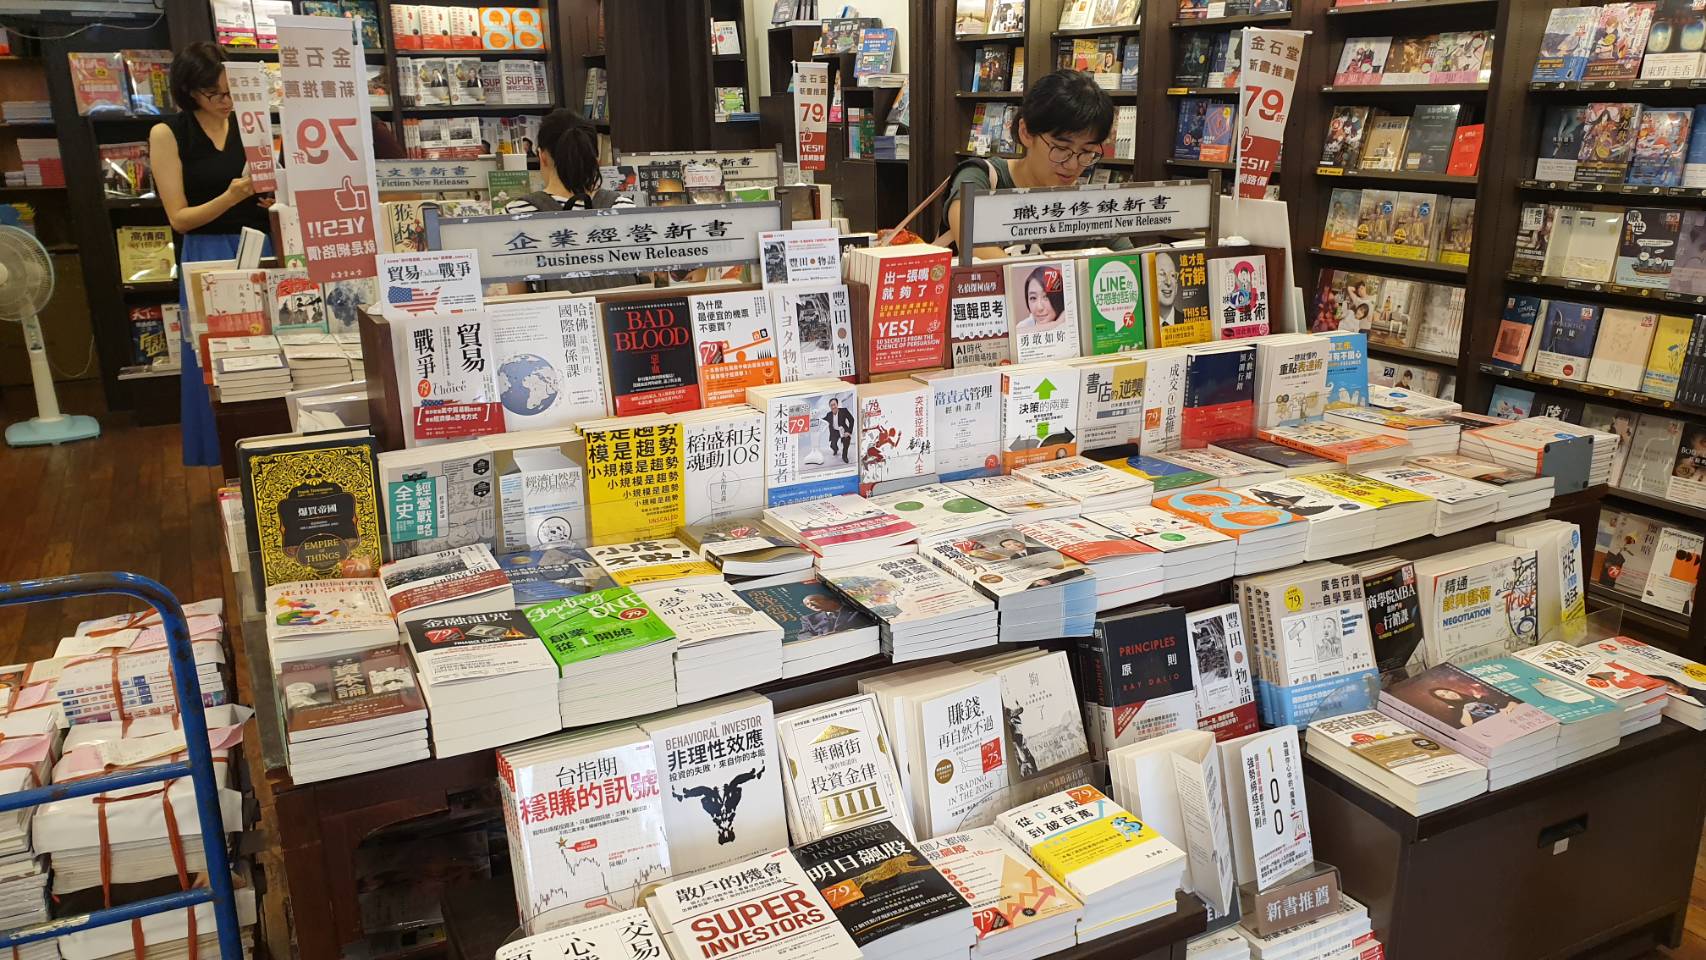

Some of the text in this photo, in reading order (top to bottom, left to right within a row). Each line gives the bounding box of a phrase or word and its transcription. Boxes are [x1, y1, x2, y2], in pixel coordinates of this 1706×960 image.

[1251, 35, 1299, 61] 金石堂
[505, 74, 534, 86] SUPER
[799, 75, 828, 84] 金石堂
[1249, 59, 1296, 82] 新書推薦
[802, 145, 824, 153] YES!!
[1240, 156, 1270, 172] ES!!
[382, 177, 470, 188] Fiction New Releases
[1013, 194, 1172, 220] 職場修鍊新書
[505, 219, 733, 251] 企業經營新書
[1010, 214, 1172, 237] Careers & Employment New Releases
[536, 245, 709, 269] Business New Releases
[1179, 253, 1206, 267] 這才是
[387, 265, 421, 283] 貿易
[438, 261, 472, 279] 戰爭
[883, 268, 930, 286] 出一張嘴
[1179, 266, 1206, 288] 行銷
[882, 284, 928, 301] 就夠了
[696, 299, 724, 311] 為什麼
[697, 308, 750, 322] 最便宜的機票
[832, 291, 847, 324] 豐田
[953, 300, 1004, 322] 邏輯思考
[1183, 305, 1209, 318] THIS IS
[1223, 303, 1267, 325] 會議術
[574, 303, 589, 332] 哈佛
[626, 307, 675, 331] BAD
[877, 319, 916, 338] YES!
[457, 322, 486, 373] 貿易
[558, 304, 581, 379] 國際關係課
[613, 327, 690, 353] BLOOD
[413, 328, 436, 379] 戰爭
[1018, 398, 1070, 415] 決策的兩難
[1165, 364, 1180, 434] 成交 思維
[790, 418, 808, 433] 79
[588, 436, 679, 465] 模是趨勢
[687, 426, 761, 454] 稻盛和夫
[775, 403, 789, 484] 未來智造者
[588, 456, 680, 480] 小規模是趨勢
[686, 444, 761, 473] 魂動108
[607, 471, 680, 491] 小規模是趨勢
[622, 483, 680, 500] 小規模是趨勢
[394, 484, 414, 521] 全史
[415, 481, 434, 537] 經營戰略
[304, 538, 340, 551] EMPIRE
[305, 552, 341, 563] THINGS
[1320, 573, 1361, 592] 廣告行銷
[1444, 575, 1469, 596] 精通
[588, 592, 643, 619] ONE
[1323, 587, 1363, 607] 自學聖經
[1442, 606, 1492, 628] NEGOTIATION
[1119, 635, 1177, 657] PRINCIPLES
[1225, 611, 1251, 705] 豐田 物語
[1148, 672, 1181, 687] DALIO
[665, 714, 763, 751] BEHAVIORAL INVESTOR
[938, 716, 995, 750] 再自然不過
[666, 729, 766, 773] 非理性效應
[811, 737, 861, 764] 華爾街
[556, 756, 618, 788] 台指期
[811, 762, 878, 795] 投資金律
[954, 775, 988, 793] TRADING
[519, 771, 661, 826] 穩賺的訊號
[948, 780, 994, 807] IN THE ZONE
[1071, 790, 1093, 802] 79
[1014, 800, 1079, 830] 從0存款
[1027, 810, 1095, 839] 到破百萬
[825, 822, 890, 846] FORWARD
[811, 832, 886, 861] INVESTING
[675, 860, 783, 902] 散戶的機會
[826, 885, 852, 903] 79
[1266, 884, 1330, 923] 新書推薦
[689, 888, 816, 943] SUPER
[972, 909, 994, 930] 79
[619, 918, 662, 960] 交易
[698, 907, 827, 960] INVESTORS
